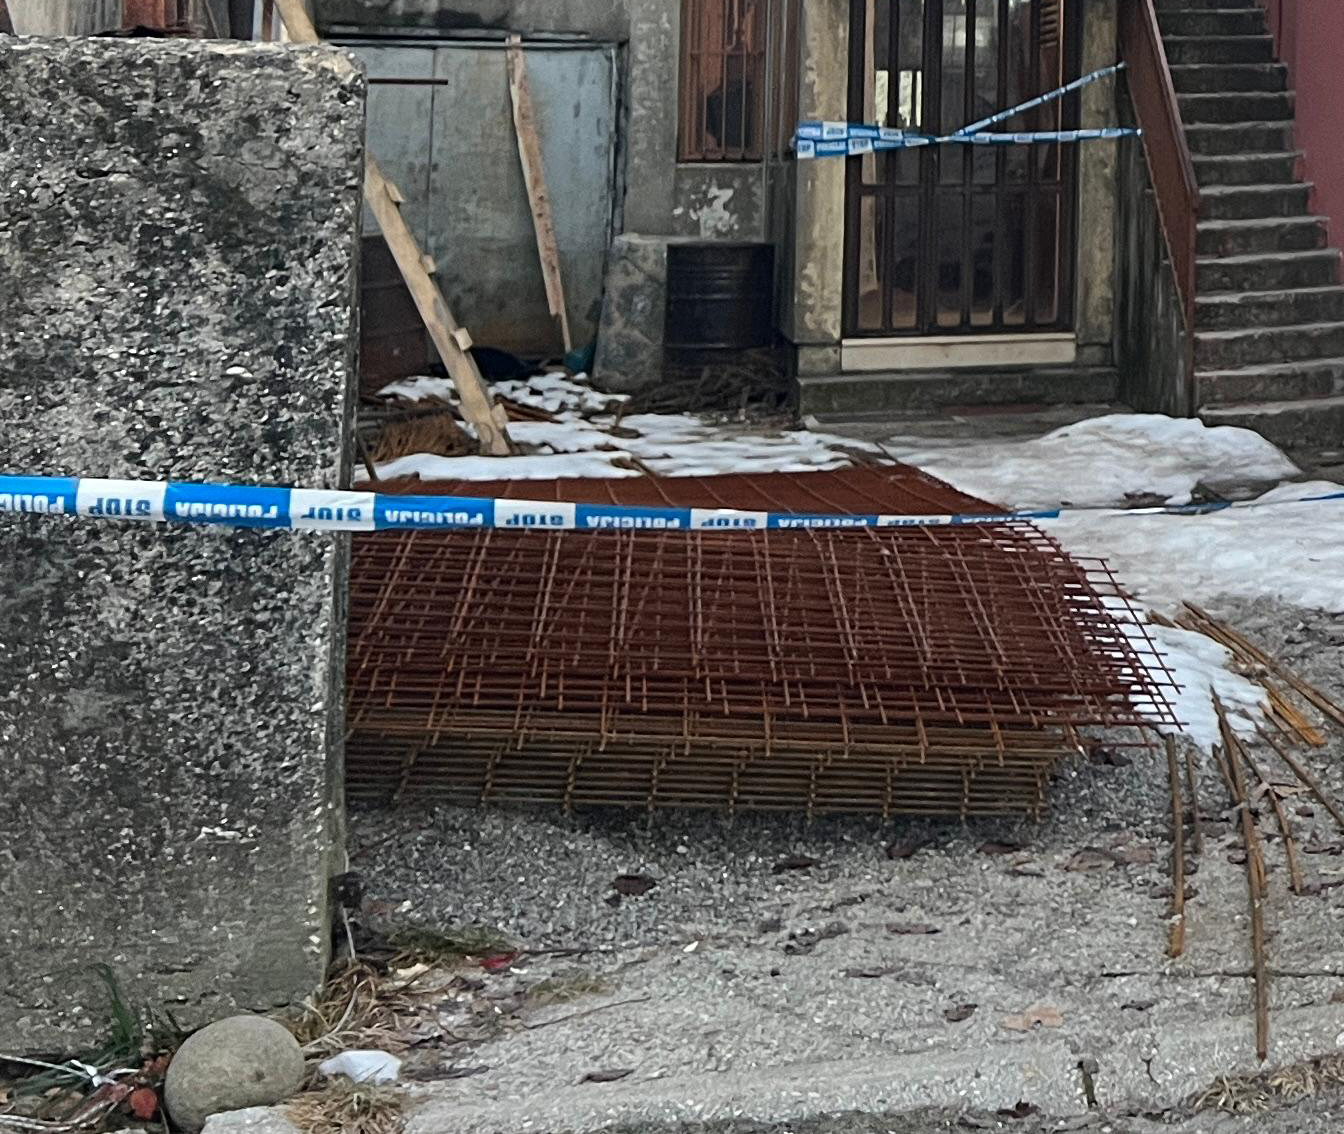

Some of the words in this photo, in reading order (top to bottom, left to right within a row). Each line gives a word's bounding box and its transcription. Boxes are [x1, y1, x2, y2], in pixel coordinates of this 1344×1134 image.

[88, 496, 151, 517] STOP
[175, 501, 278, 519] POLICIJA
[384, 509, 484, 525] POLICIJA
[506, 513, 564, 527] STOP
[586, 515, 680, 528] POLICIJA
